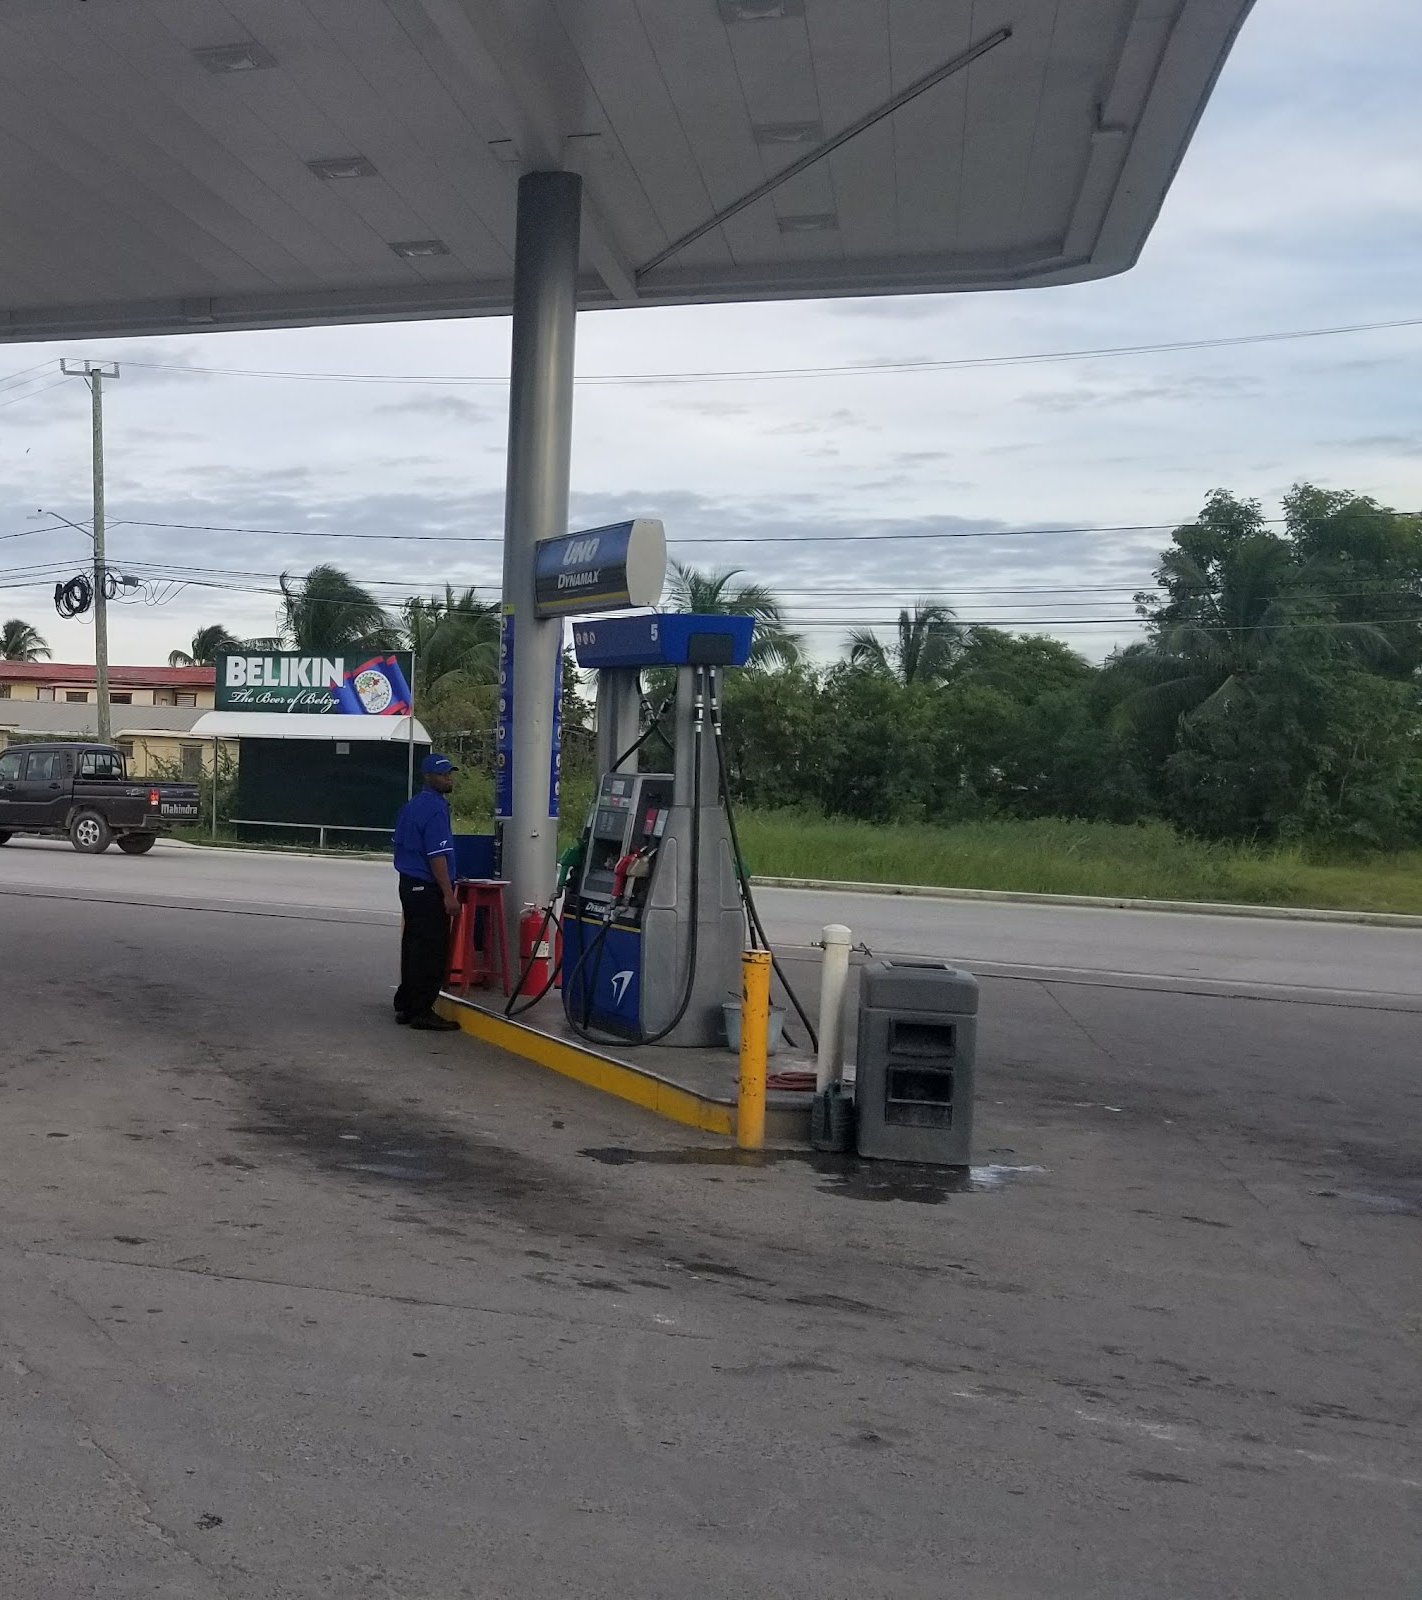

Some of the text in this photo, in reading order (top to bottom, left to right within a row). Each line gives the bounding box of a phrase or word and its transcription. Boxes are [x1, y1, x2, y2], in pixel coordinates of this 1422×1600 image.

[563, 538, 600, 566] UNO
[558, 570, 600, 589] DYNAMAX
[650, 623, 658, 641] 5
[225, 655, 345, 688] BELIKIN
[227, 689, 341, 713] The Beer of Belize
[161, 803, 198, 814] Mahindra
